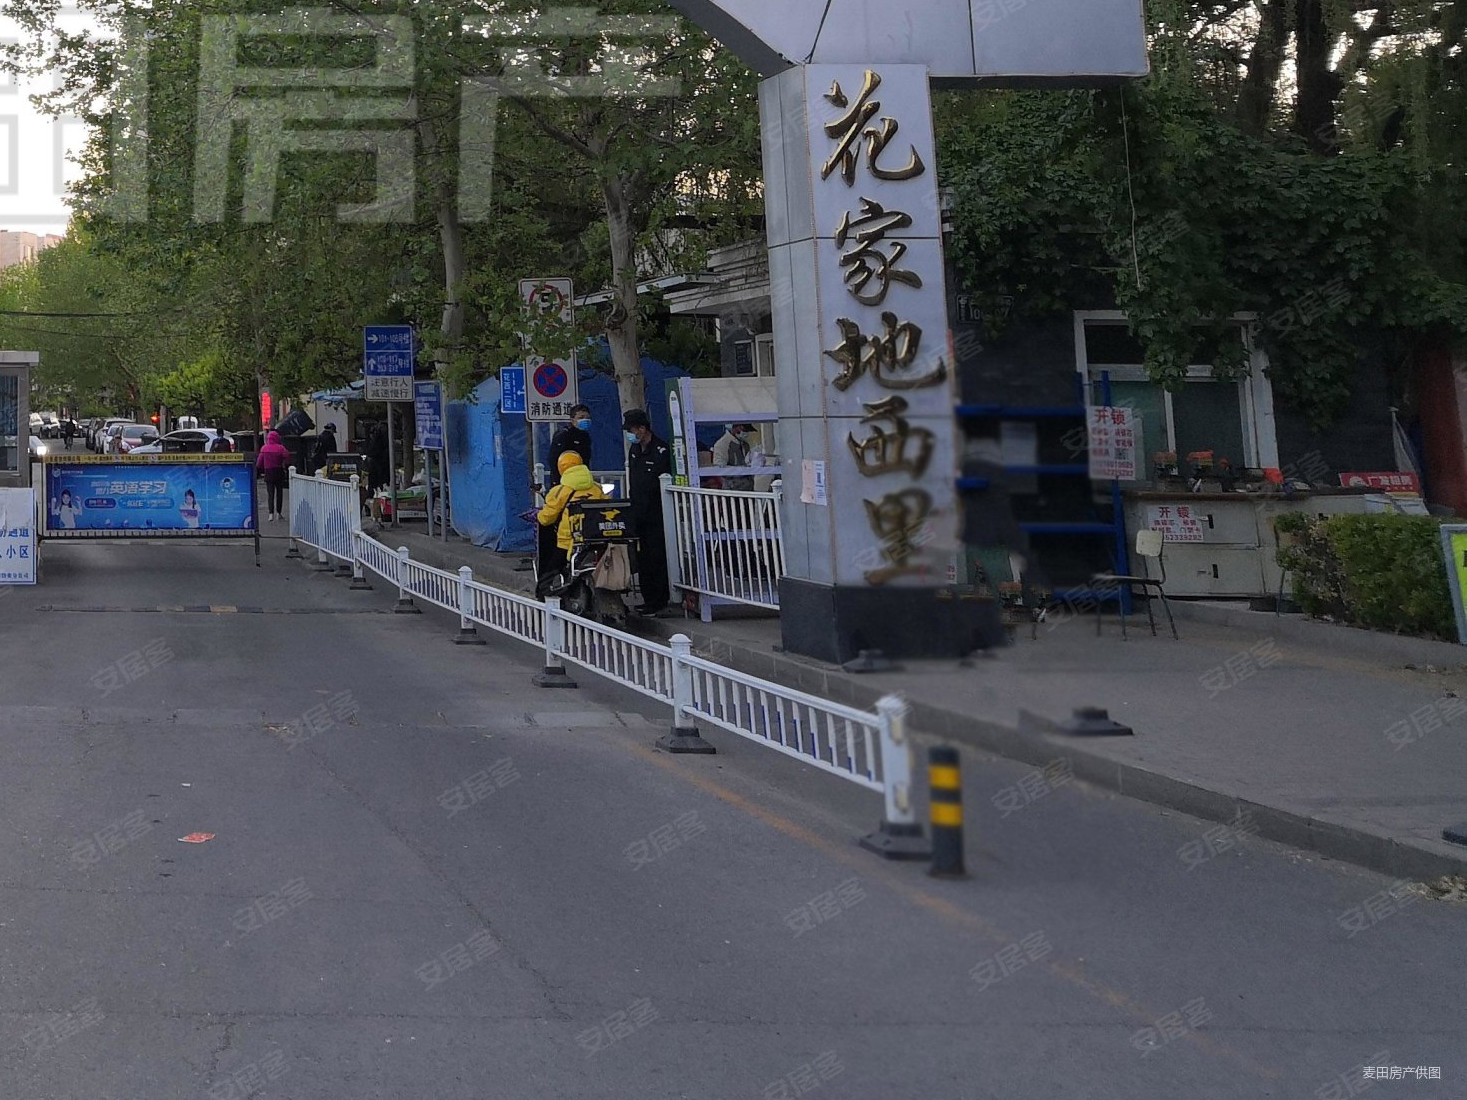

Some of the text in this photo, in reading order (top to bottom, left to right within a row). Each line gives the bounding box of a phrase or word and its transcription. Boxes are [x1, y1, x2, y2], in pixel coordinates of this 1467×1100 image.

[821, 69, 947, 587] 花家地西里
[371, 377, 408, 387] 注意行人
[371, 388, 408, 398] 减速慢行
[530, 402, 573, 416] 消防通道
[1094, 409, 1126, 425] 开锁
[110, 480, 168, 495] 英语学习
[1158, 506, 1191, 518] 开锁
